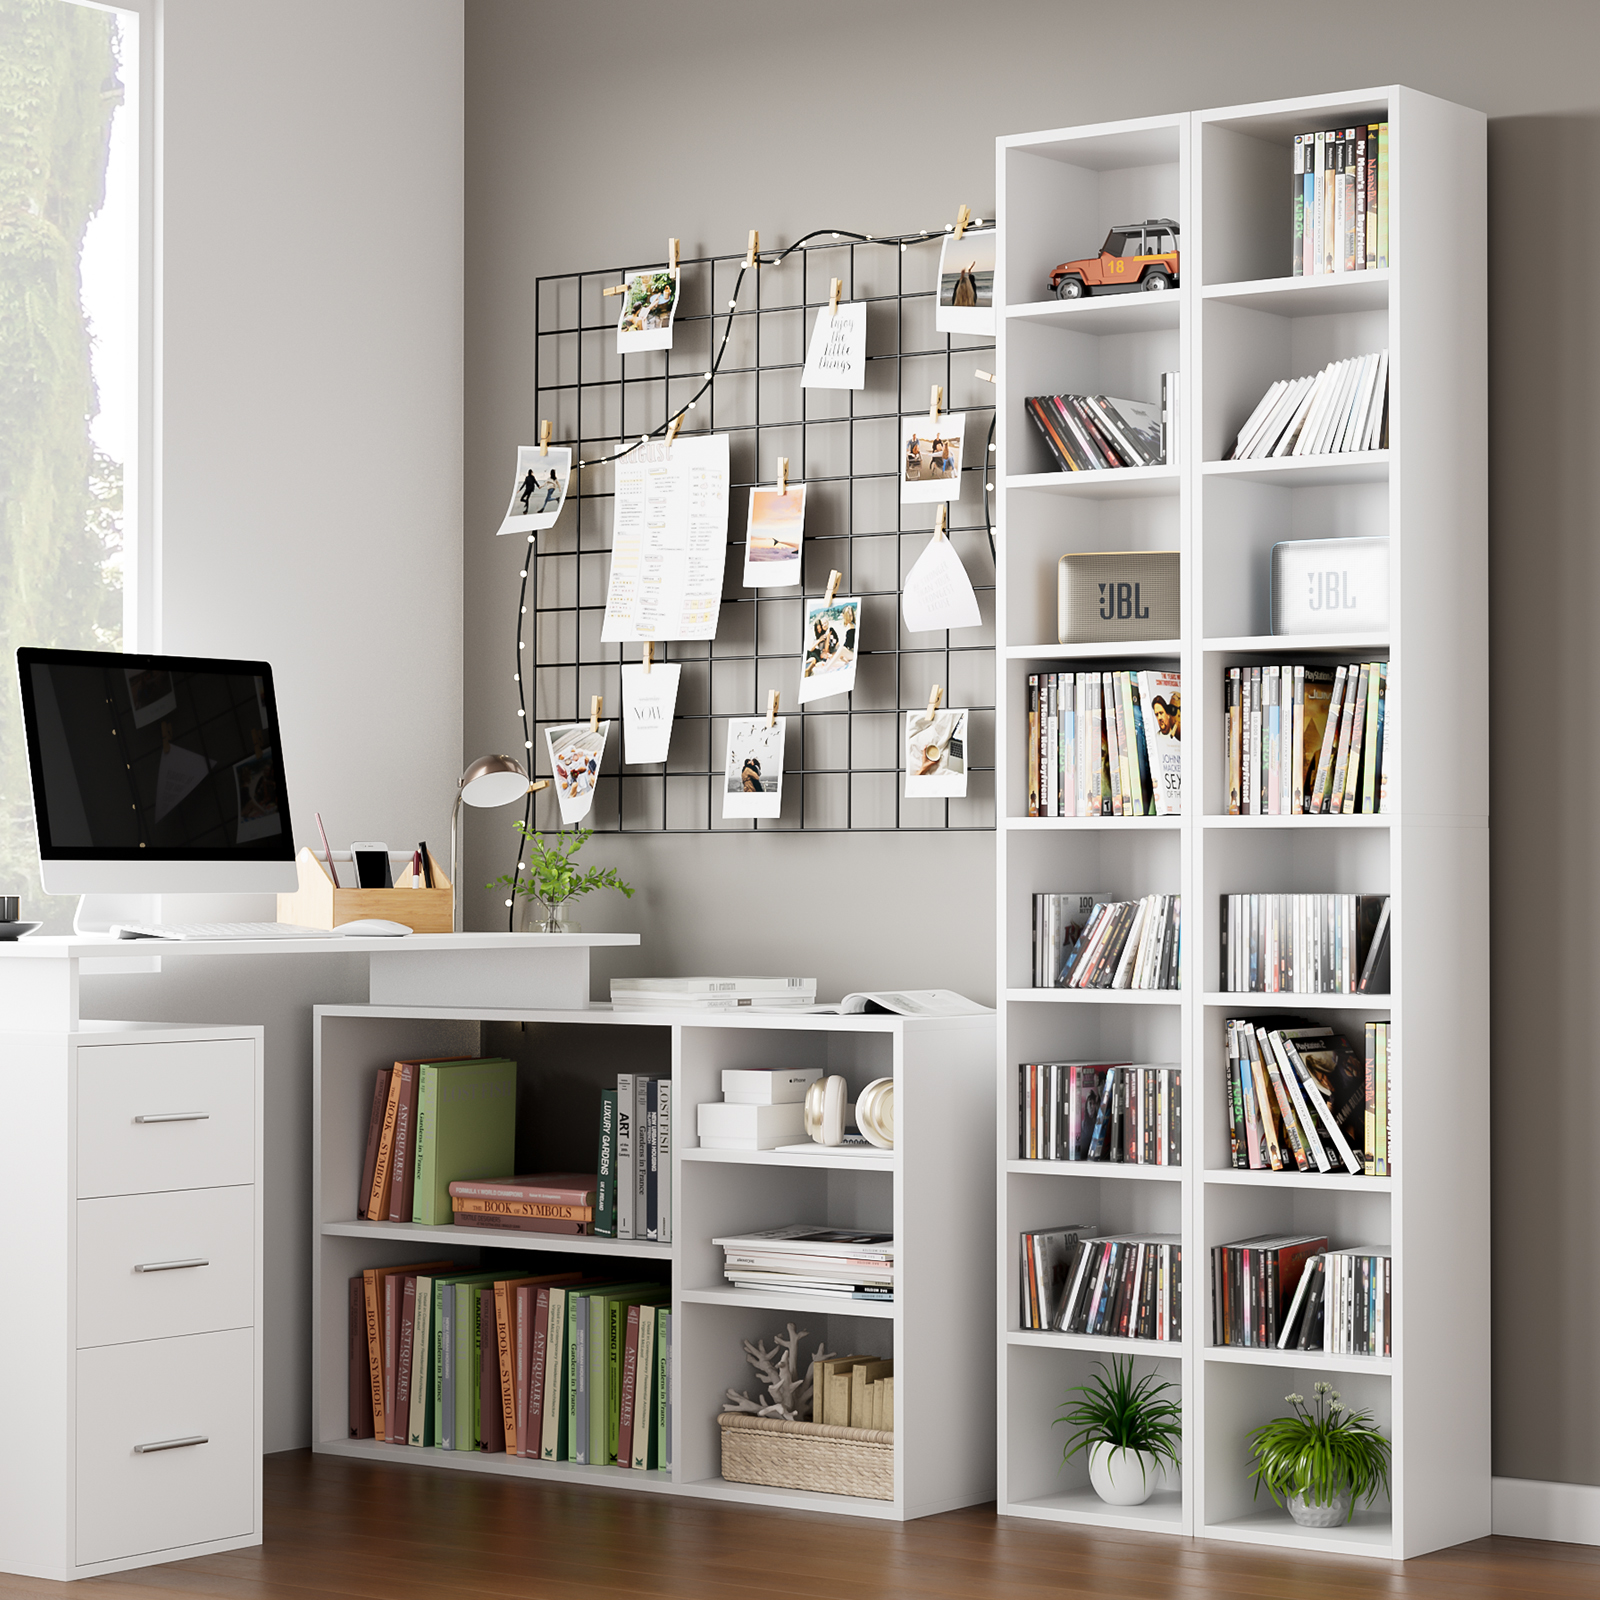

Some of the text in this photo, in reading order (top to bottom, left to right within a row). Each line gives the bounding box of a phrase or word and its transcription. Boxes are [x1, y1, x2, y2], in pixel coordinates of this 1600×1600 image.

[1356, 140, 1365, 155] My
[1367, 158, 1377, 202] NARNIA
[1356, 214, 1365, 264] Boyfriend
[1108, 260, 1124, 274] 18
[1098, 582, 1149, 620] JBL
[1307, 570, 1357, 611] JBL
[1040, 688, 1048, 702] My
[1242, 682, 1250, 695] My
[1040, 758, 1048, 805] Boyfriend
[1242, 754, 1250, 803] Boyfriend
[1079, 896, 1093, 908] 100
[443, 1081, 511, 1103] LOST FISH
[1273, 1080, 1289, 1119] NARNIA
[1365, 1058, 1375, 1102] NARNIA
[384, 1100, 396, 1131] BOOK
[602, 1100, 612, 1134] LUXURY
[660, 1085, 669, 1154] LOST FISH
[1232, 1079, 1243, 1122] TUROK
[395, 1104, 408, 1183] ANTIQUAIRES
[619, 1112, 630, 1139] ART
[372, 1142, 388, 1199] SYMBOLS
[601, 1135, 610, 1176] GARDENS
[484, 1201, 512, 1213] BOOK
[522, 1204, 572, 1218] SYMBOLS
[1064, 1233, 1079, 1245] 100
[367, 1310, 377, 1344] BOOK
[457, 1289, 466, 1360] LOST FISH
[498, 1322, 508, 1357] BOOK
[592, 1301, 601, 1373] LOST FISH
[401, 1319, 412, 1402] ANTIQUAIRES
[437, 1365, 442, 1373] in
[533, 1332, 545, 1415] ANTIQUAIRES
[610, 1352, 617, 1363] IT
[370, 1357, 383, 1417] SYMBOLS
[502, 1370, 514, 1430] SYMBOLS
[571, 1378, 577, 1386] in
[623, 1347, 635, 1426] ANTIQUAIRES
